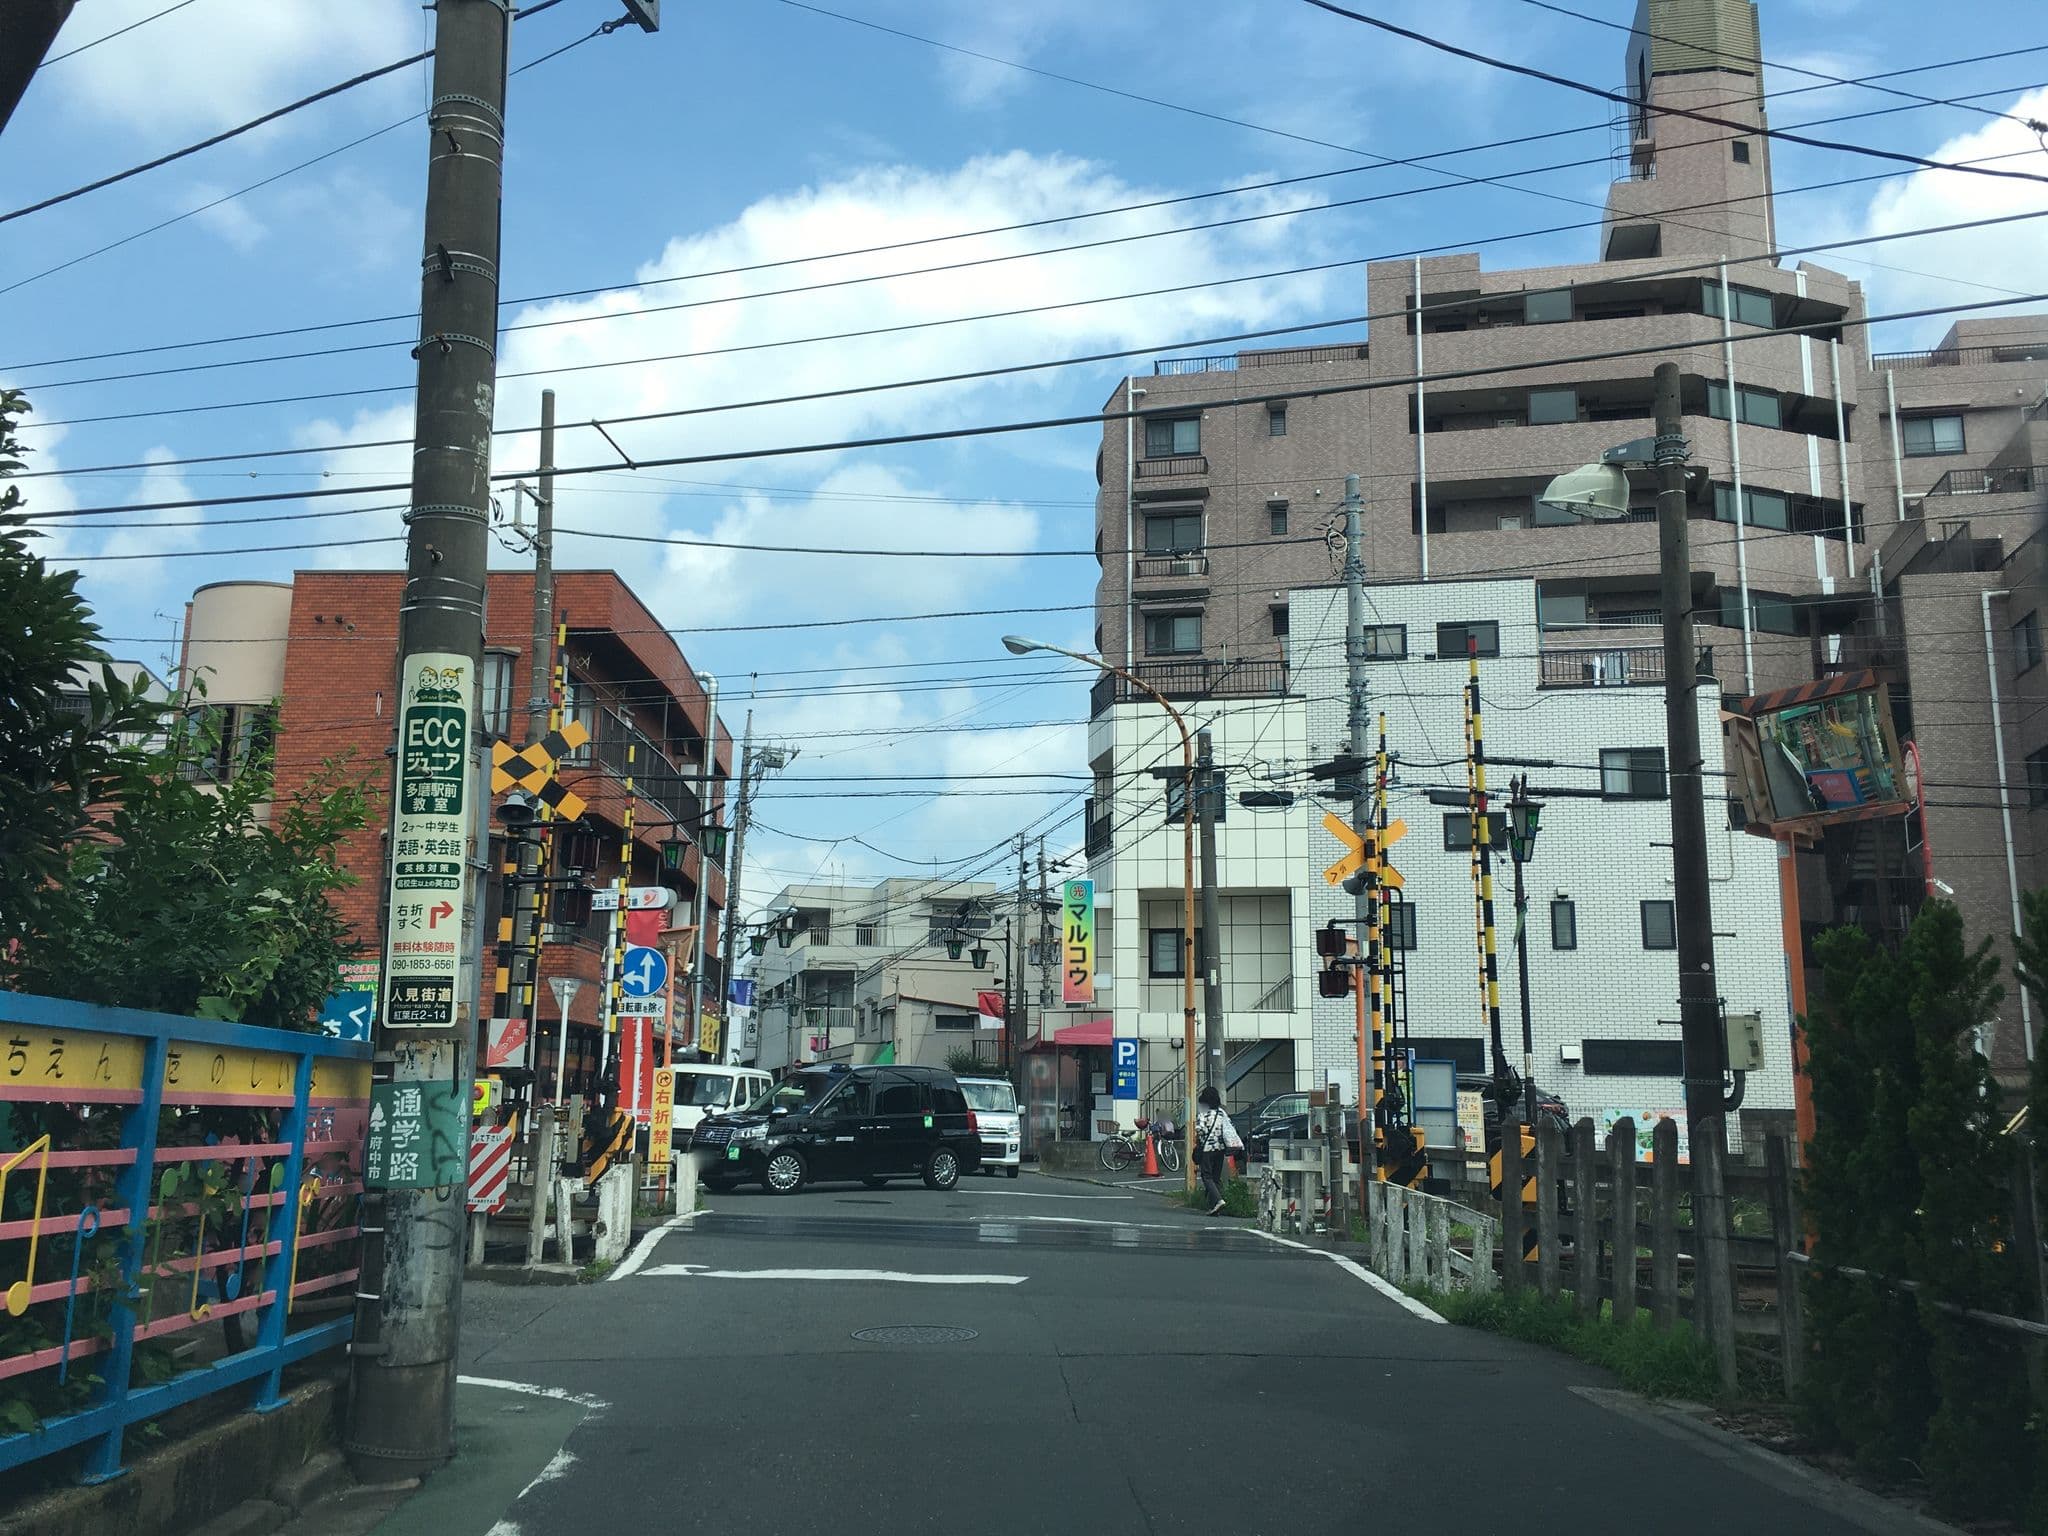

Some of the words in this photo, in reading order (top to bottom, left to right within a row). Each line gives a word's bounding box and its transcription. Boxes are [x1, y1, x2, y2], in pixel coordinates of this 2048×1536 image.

[408, 717, 461, 748] ECC
[407, 752, 461, 772] ジュニア
[406, 782, 457, 798] 多磨駅前
[412, 798, 449, 812] 教室
[404, 864, 449, 873] 英検対策
[397, 879, 458, 889] 高校生以上の英会話
[397, 903, 424, 917] 右折
[397, 918, 422, 930] すぐ
[393, 941, 455, 954] 無料体験随時
[1067, 903, 1089, 987] マルコウ
[392, 959, 454, 970] 090-1853-6561
[391, 987, 452, 1002] 人見街道
[1118, 1042, 1136, 1065] P
[653, 1089, 671, 1164] 右折禁止
[388, 1088, 422, 1181] 通学路
[368, 1136, 383, 1180] 府中市
